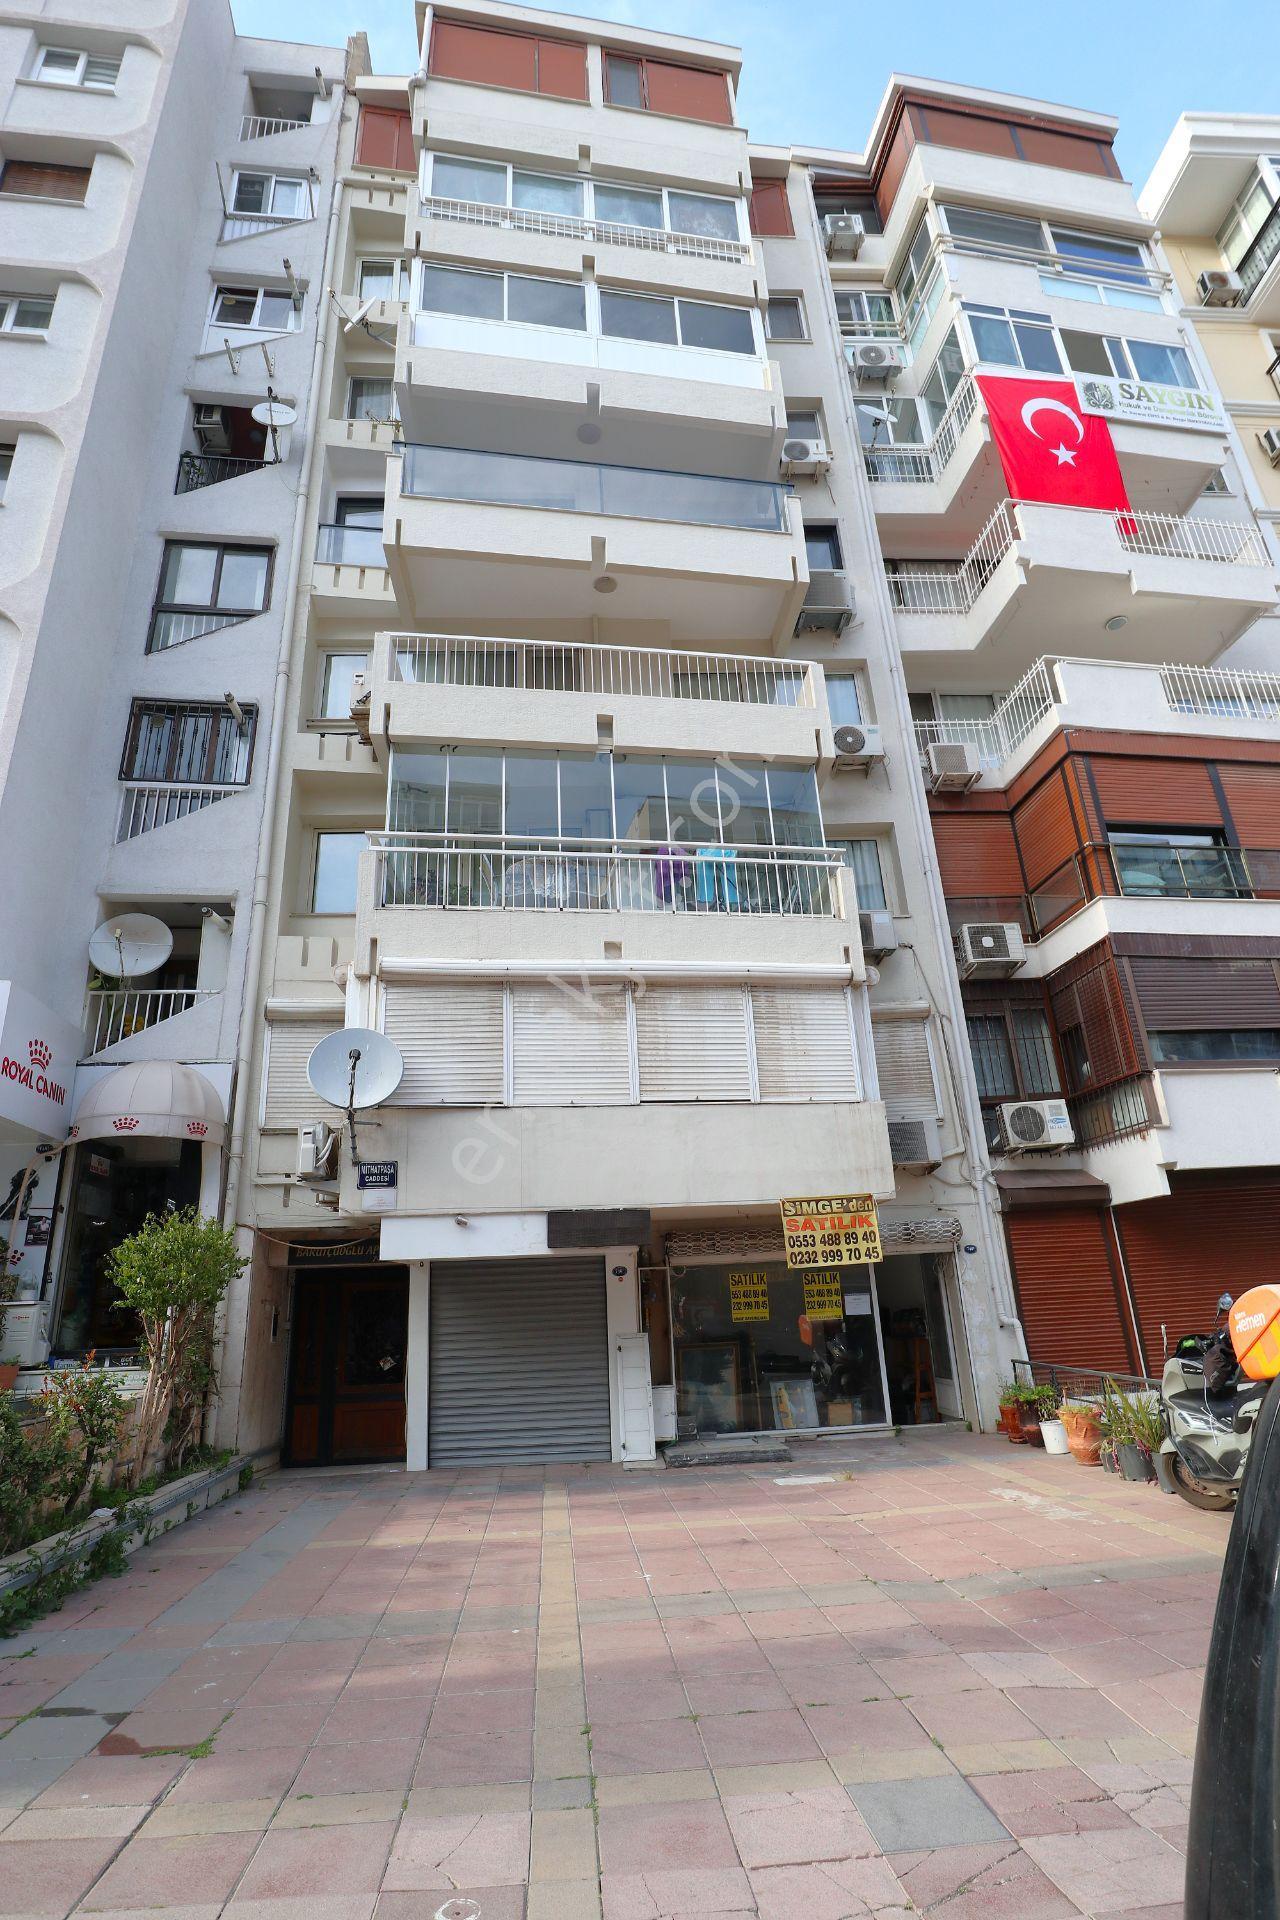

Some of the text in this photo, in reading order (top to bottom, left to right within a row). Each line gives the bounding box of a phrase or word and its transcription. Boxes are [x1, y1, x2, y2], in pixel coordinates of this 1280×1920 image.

[1118, 383, 1214, 411] SAYGIN
[1, 1056, 66, 1106] ROYAL CANIN
[786, 1214, 874, 1232] SATILIK
[788, 1229, 876, 1248] 0553 488 89 40
[790, 1246, 880, 1265] 0232 999 70 45
[730, 1273, 767, 1286] SATILIK
[804, 1273, 839, 1285] SATILIK
